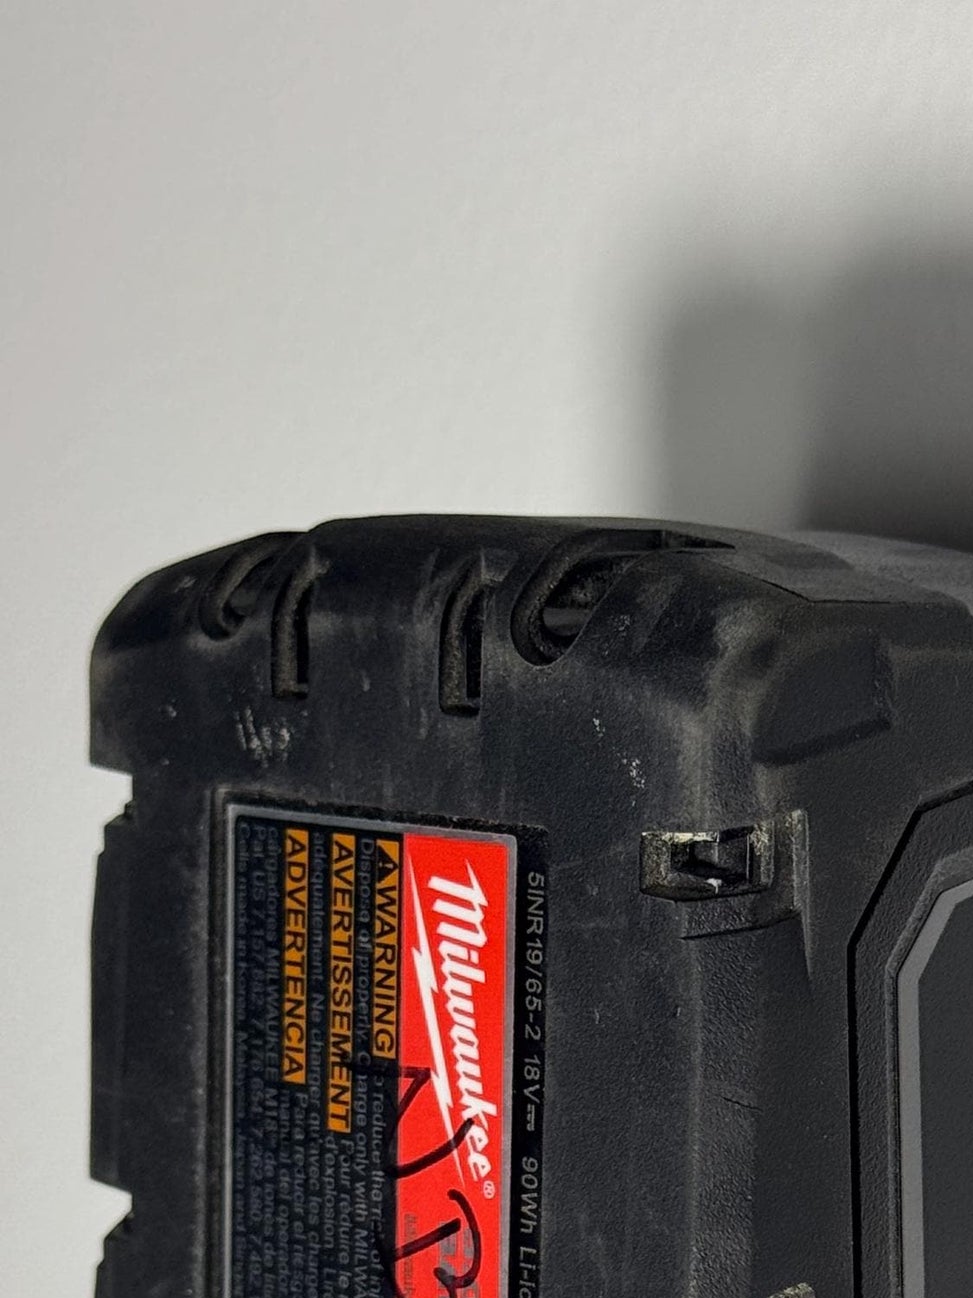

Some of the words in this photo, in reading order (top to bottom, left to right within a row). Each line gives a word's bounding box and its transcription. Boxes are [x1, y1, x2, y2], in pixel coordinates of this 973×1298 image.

[356, 838, 375, 923] Dispose
[284, 835, 306, 1077] ADVERTENCIA
[374, 886, 397, 1053] WARNING
[524, 871, 545, 1041] 5INR19/65-2
[310, 993, 325, 1023] Ne
[330, 840, 354, 1129] AVERTISSEMENT
[309, 1028, 325, 1109] charger
[292, 1092, 307, 1141] Para
[338, 1138, 355, 1189] Pour
[353, 1132, 369, 1176] only
[354, 1180, 369, 1223] with
[370, 1169, 385, 1202] the
[519, 1156, 539, 1234] 90Wh
[308, 1196, 322, 1226] les
[338, 1270, 353, 1289] le
[369, 1249, 384, 1269] of
